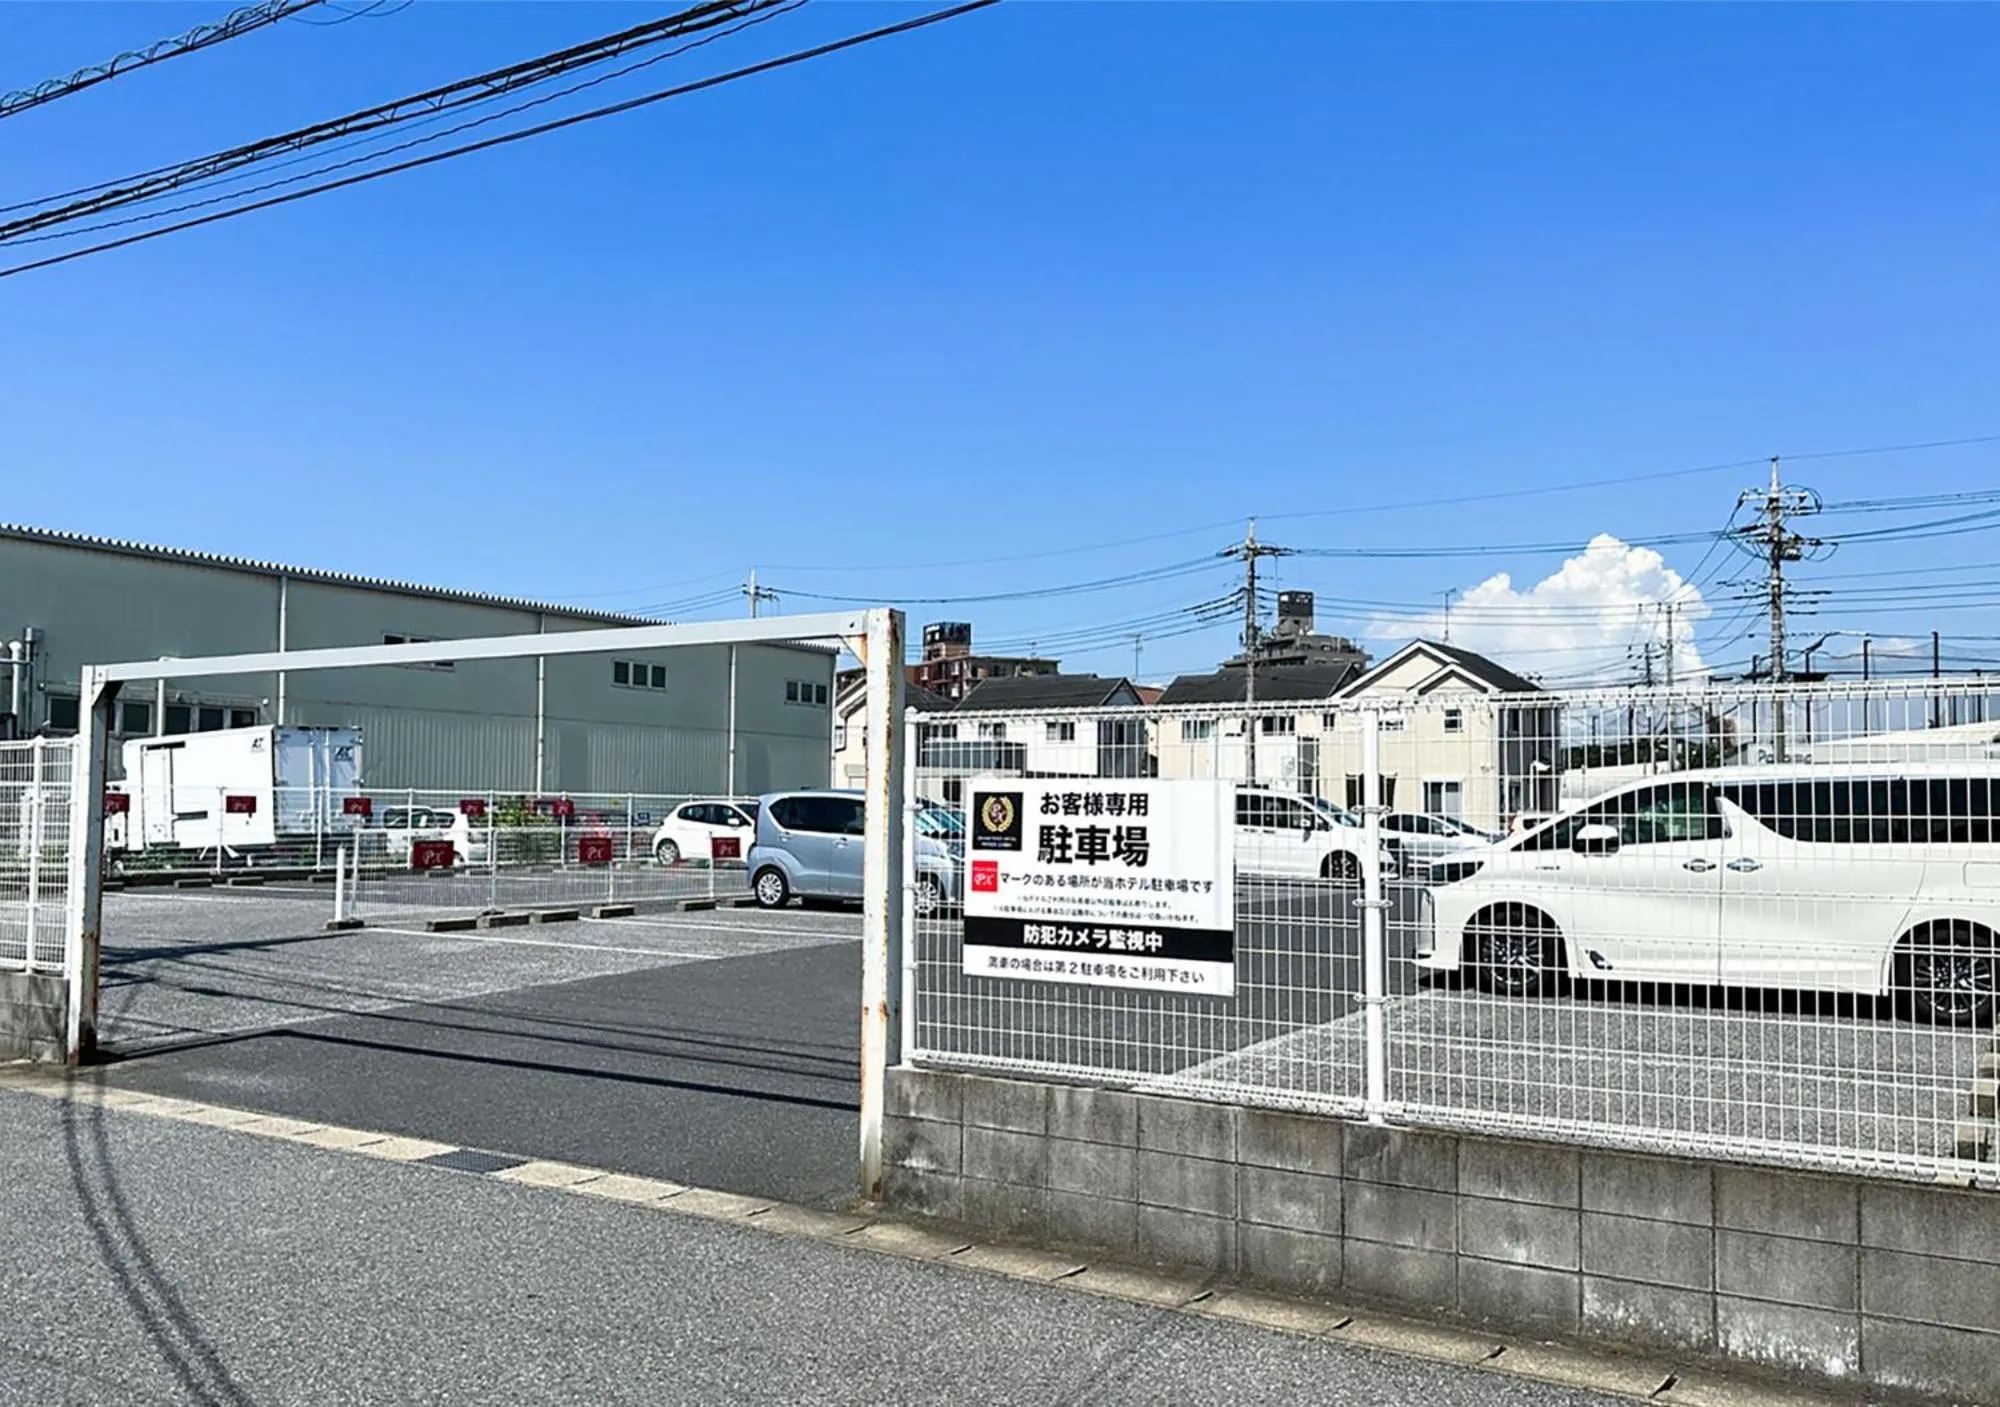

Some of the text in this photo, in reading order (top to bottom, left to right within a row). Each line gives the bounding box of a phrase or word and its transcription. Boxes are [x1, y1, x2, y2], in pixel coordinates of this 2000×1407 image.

[1758, 749, 1812, 765] Paoma
[1039, 792, 1149, 817] お客様専用
[1037, 824, 1150, 868] 駐車場
[1000, 872, 1214, 894] マークのある場所が当ホテル駐車場です
[1023, 924, 1163, 952] 防犯カメラ監視中
